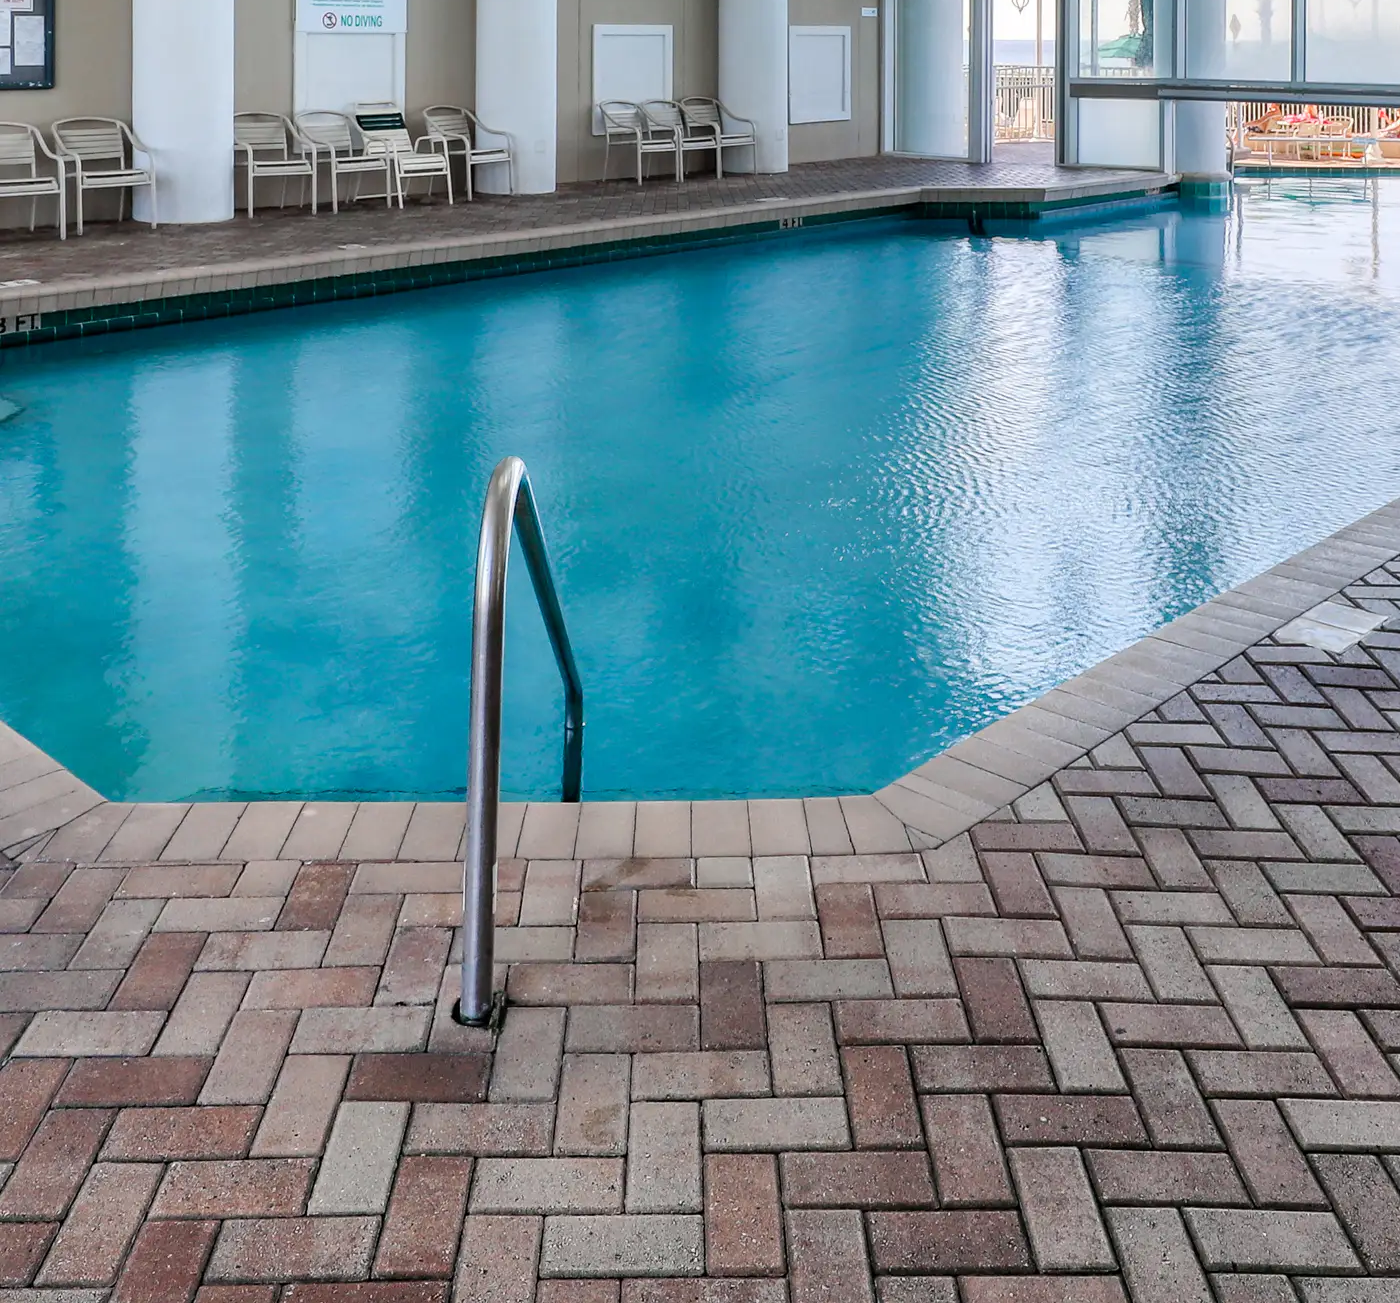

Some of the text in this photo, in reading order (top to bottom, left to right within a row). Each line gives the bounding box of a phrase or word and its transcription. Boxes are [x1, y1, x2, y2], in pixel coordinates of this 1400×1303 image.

[340, 14, 383, 28] NO DIVING
[782, 218, 789, 230] 4
